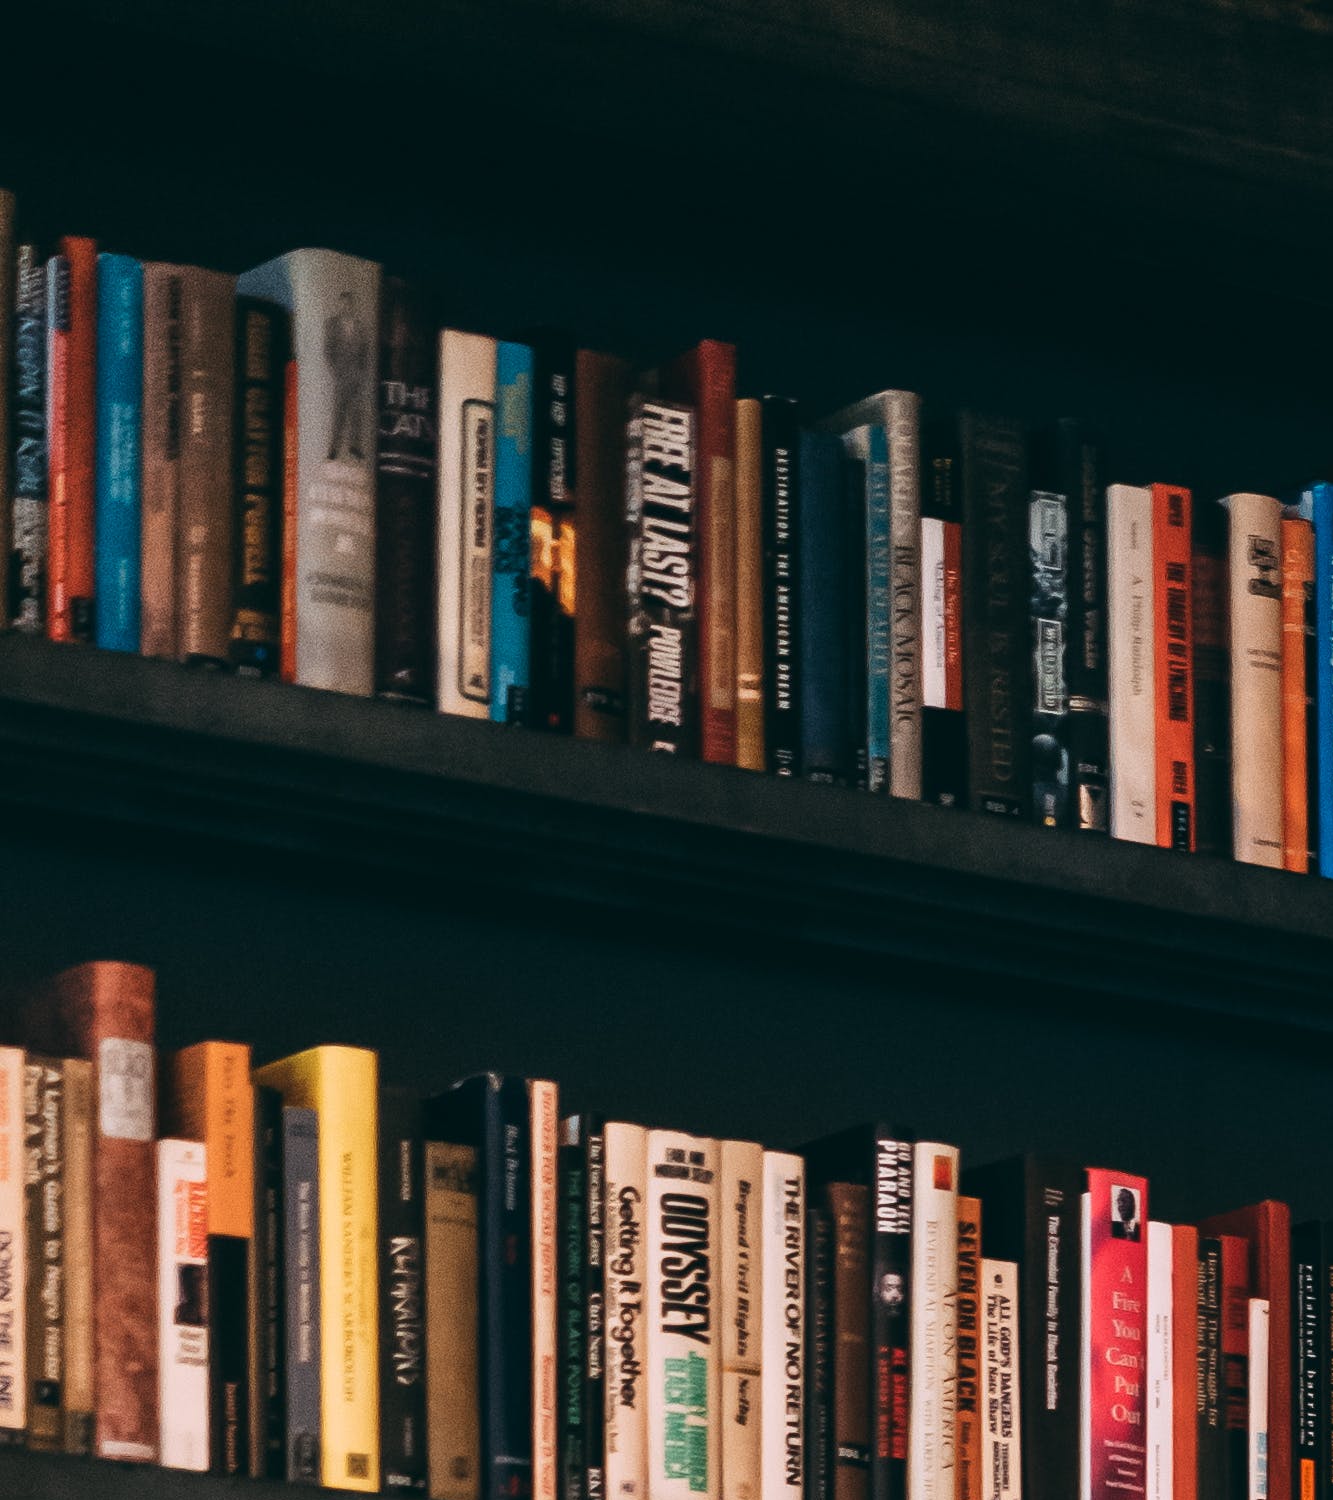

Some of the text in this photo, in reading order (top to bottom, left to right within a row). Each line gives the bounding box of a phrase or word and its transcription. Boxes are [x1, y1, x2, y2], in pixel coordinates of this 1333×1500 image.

[641, 404, 692, 607] FREE AT LAST?
[647, 624, 681, 724] POWLEDGE
[660, 1192, 711, 1346] ODYSSEY
[784, 1177, 802, 1486] THE RIVER OF NO RETURN
